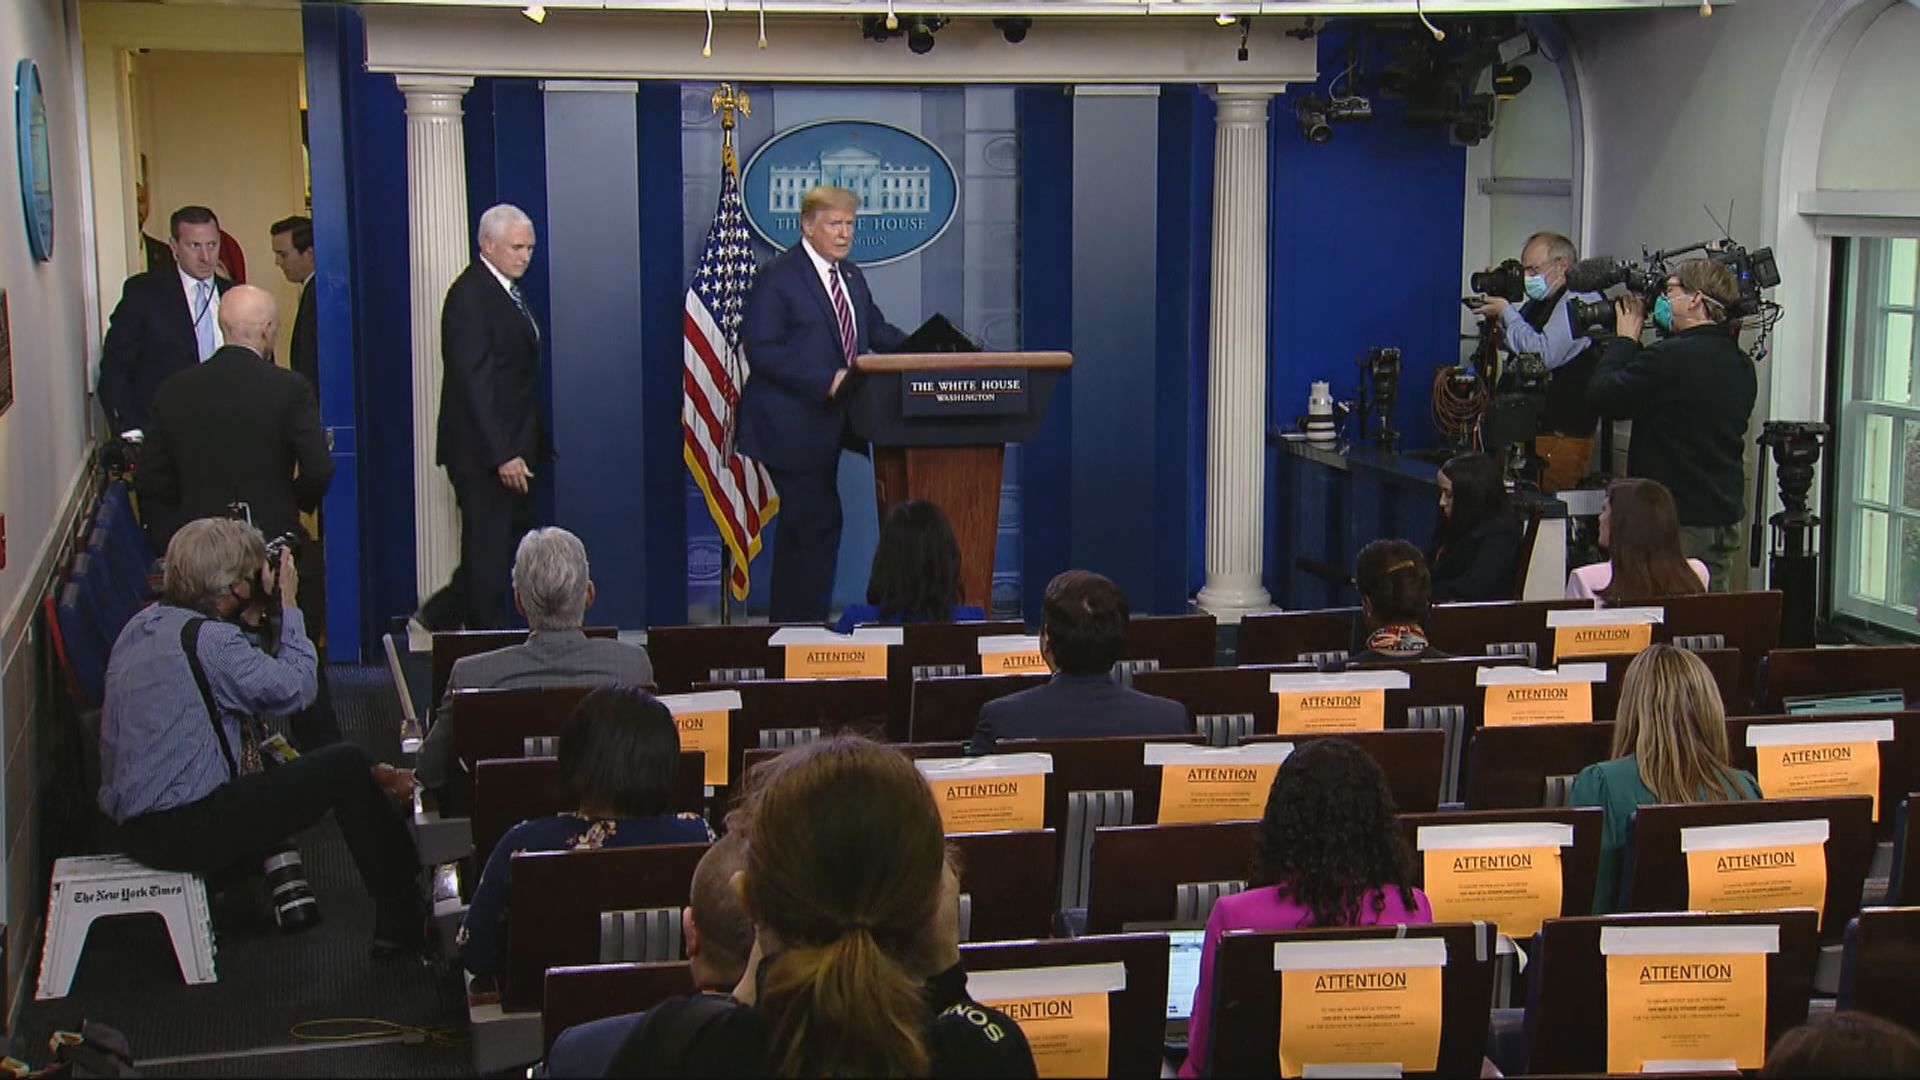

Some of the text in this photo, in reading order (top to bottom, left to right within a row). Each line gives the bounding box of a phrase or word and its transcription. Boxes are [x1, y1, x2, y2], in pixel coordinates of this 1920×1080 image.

[775, 217, 800, 230] TH
[874, 217, 927, 230] HOUSE
[910, 380, 1021, 392] THE WHITE HOUSE
[936, 393, 995, 402] WASHINGTON
[1575, 628, 1630, 640] ATTENTION
[806, 650, 866, 662] ATTENTION
[1506, 688, 1568, 700] ATTENTION
[1300, 696, 1361, 707] ATTENTION
[1782, 747, 1852, 765] ATTENTION
[1187, 768, 1257, 780] ATTENTION
[946, 782, 1018, 799] ATTENTION
[1453, 854, 1532, 870] ATTENTION
[1717, 852, 1796, 870] ATTENTION
[73, 885, 183, 903] The New York Times
[1640, 964, 1732, 980] ATTENTION
[1315, 972, 1407, 990] ATTENTION
[997, 1000, 1072, 1018] TENTION
